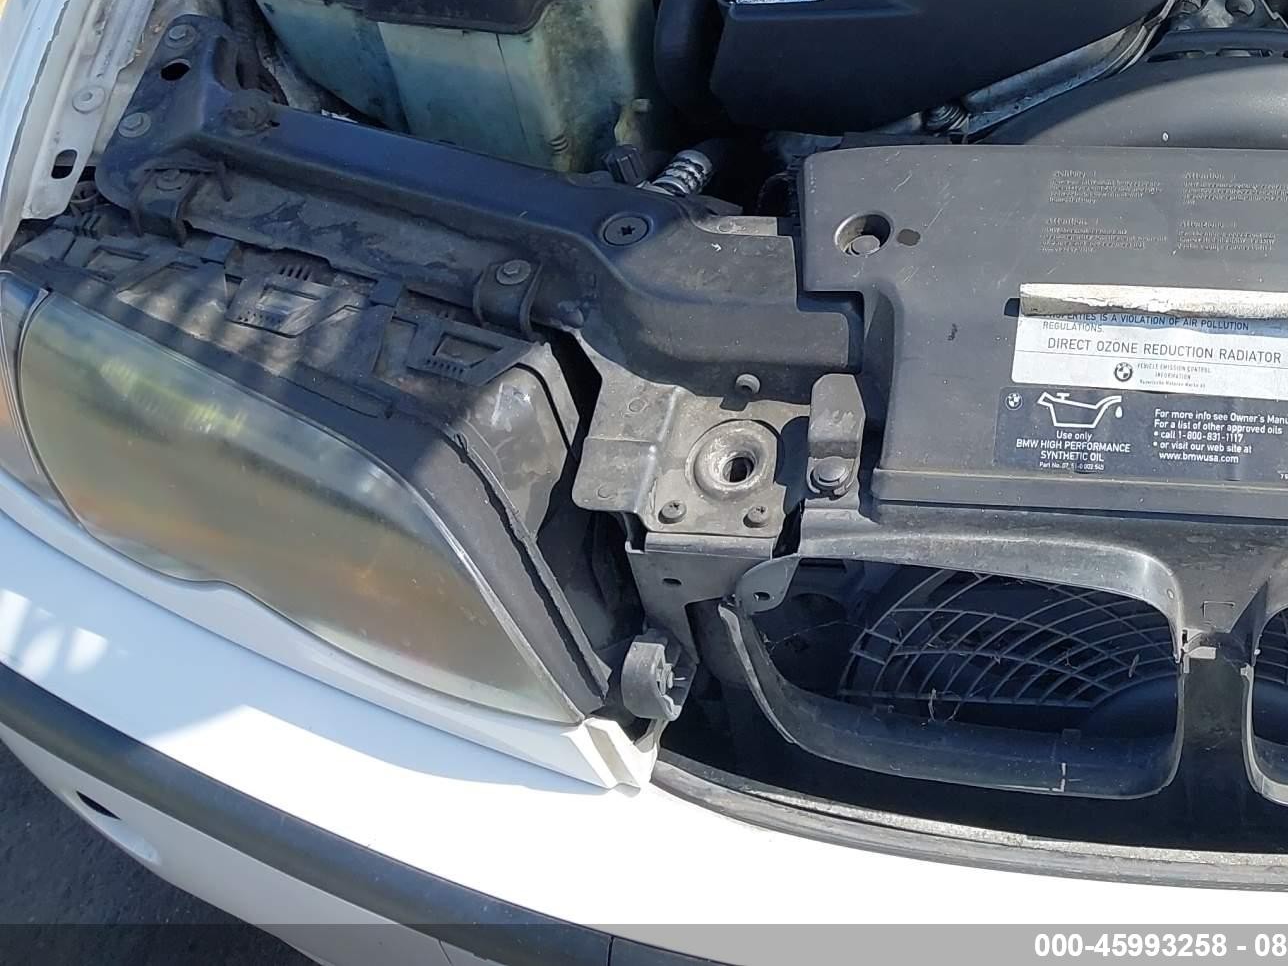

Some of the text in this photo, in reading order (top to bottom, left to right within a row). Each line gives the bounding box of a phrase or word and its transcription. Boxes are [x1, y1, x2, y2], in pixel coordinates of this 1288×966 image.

[1100, 314, 1108, 322] IS
[1111, 314, 1118, 323] A
[1120, 315, 1165, 325] VIOLATION
[1168, 318, 1180, 326] OF
[1183, 319, 1197, 328] AIR
[1200, 319, 1249, 331] POLLUTION
[1048, 337, 1282, 364] DIRECT OZONE REDUCTION RADIATOR
[1155, 409, 1169, 418] For
[1171, 411, 1193, 419] more
[1195, 411, 1211, 421] info
[1213, 413, 1228, 421] see
[1154, 419, 1168, 428] For
[1177, 420, 1191, 429] list
[1192, 421, 1202, 430] of
[1203, 422, 1225, 431] other
[1227, 424, 1266, 434] approved
[1267, 425, 1283, 434] oils
[1056, 430, 1093, 442] Use only
[1160, 431, 1176, 439] call
[1016, 439, 1131, 453] BMW HIGH PERFORMANCE
[1159, 441, 1252, 454] or visit our web site at
[1040, 450, 1105, 462] SYNTHETIC OIL
[1158, 451, 1239, 463] www.bmwusa.com
